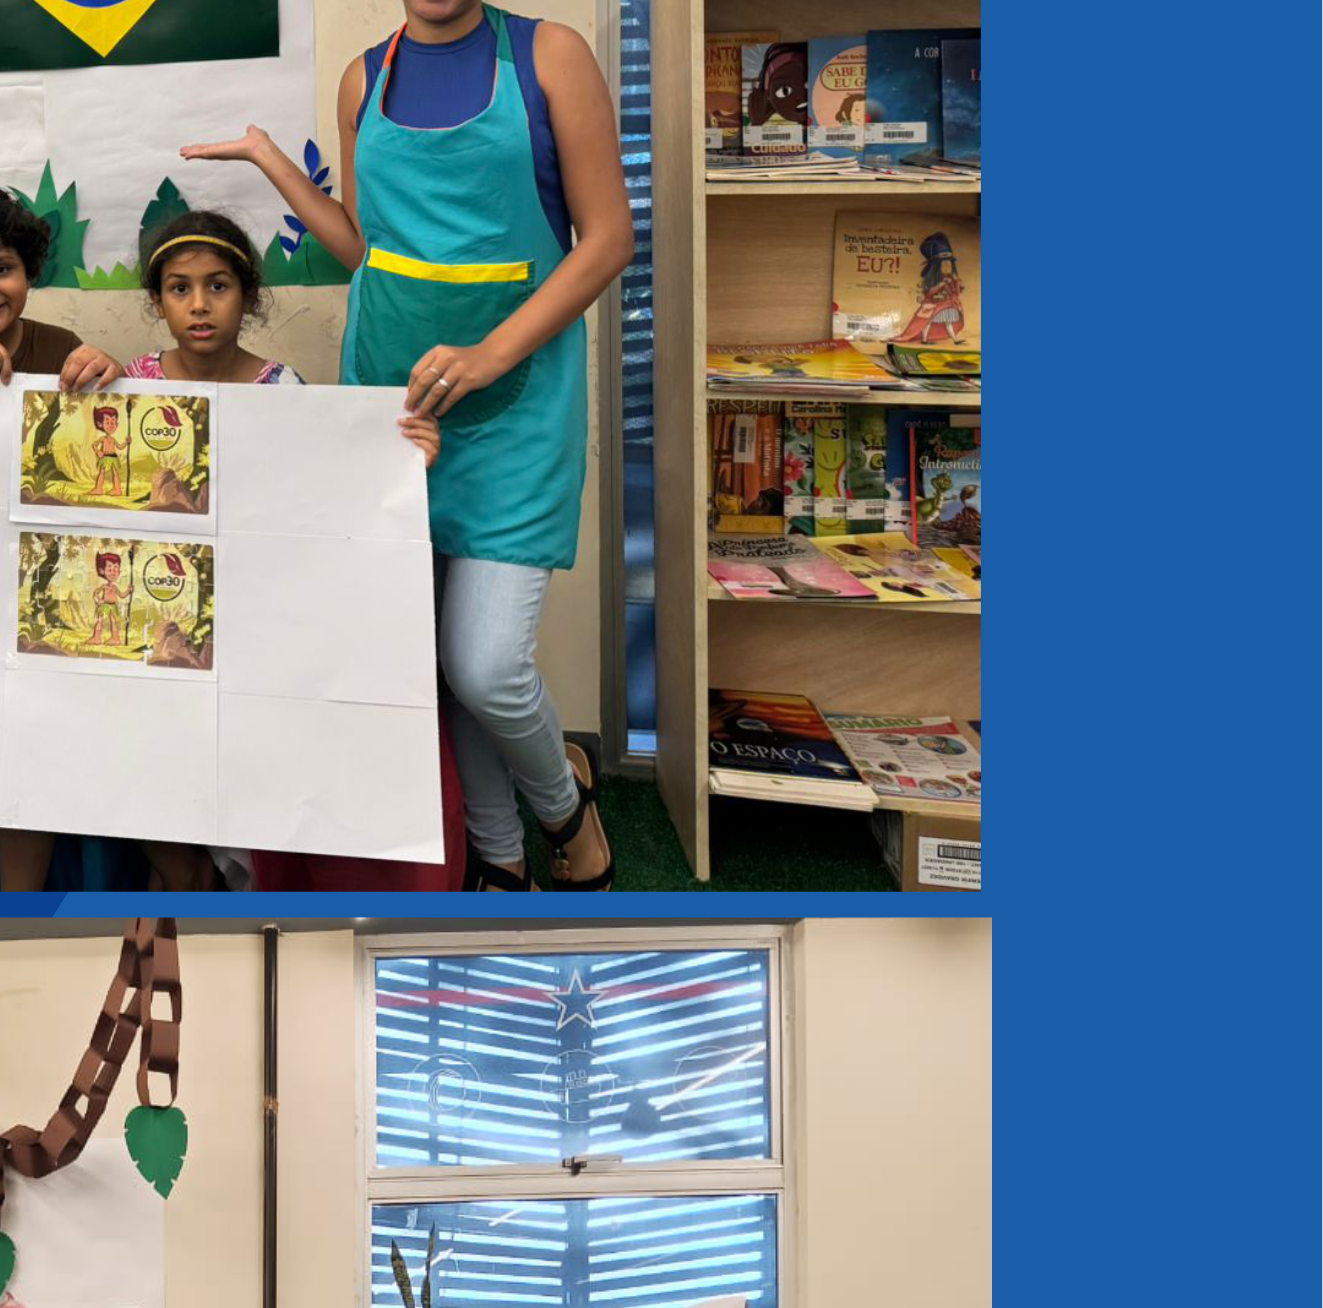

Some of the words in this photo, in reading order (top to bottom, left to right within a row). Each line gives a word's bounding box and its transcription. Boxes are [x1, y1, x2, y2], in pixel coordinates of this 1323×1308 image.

[826, 66, 857, 78] SABE
[834, 78, 852, 88] EU
[843, 234, 914, 246] Inventadeira
[844, 244, 858, 253] de
[861, 244, 912, 255] besteira,
[856, 255, 900, 274] EU?!
[144, 426, 177, 438] COP30
[147, 575, 181, 588] COP30
[709, 740, 729, 755] O
[734, 744, 818, 765] ESPAÇO
